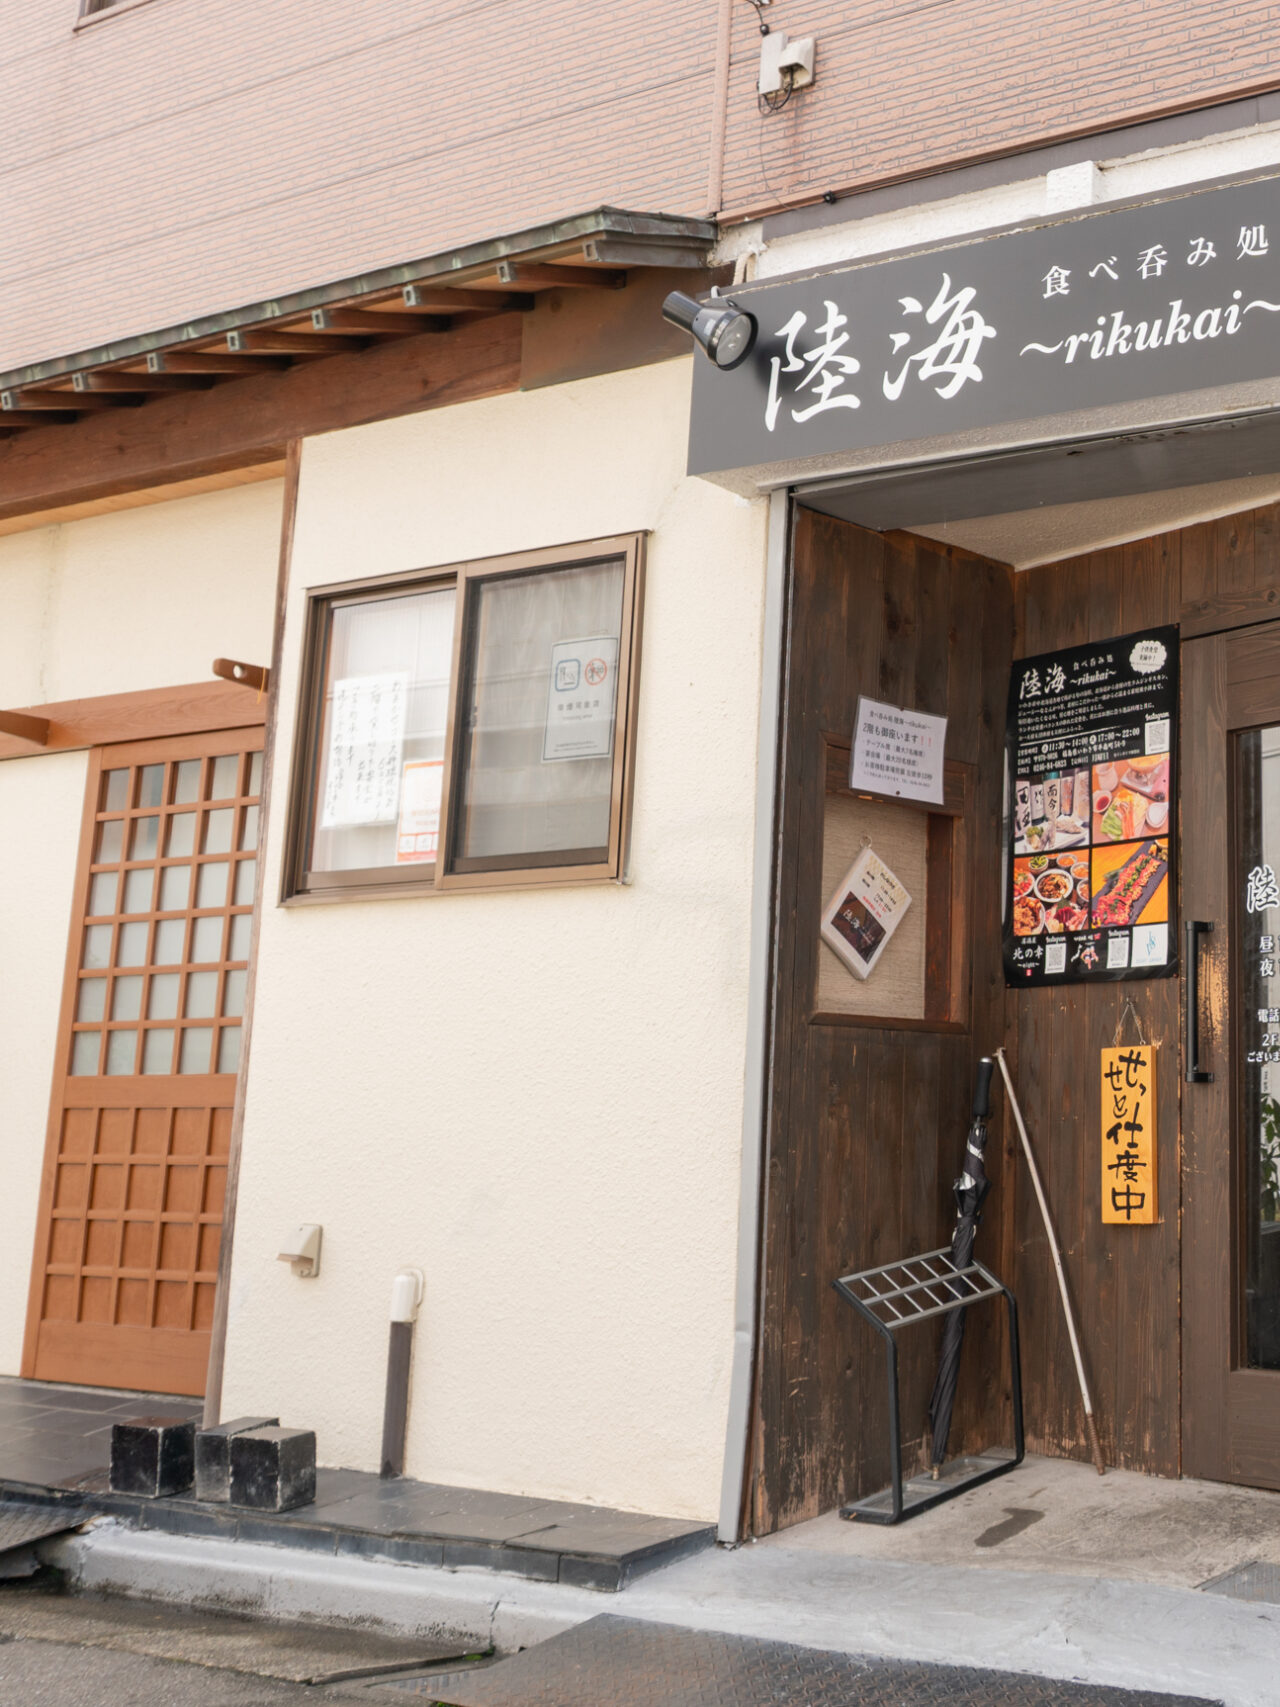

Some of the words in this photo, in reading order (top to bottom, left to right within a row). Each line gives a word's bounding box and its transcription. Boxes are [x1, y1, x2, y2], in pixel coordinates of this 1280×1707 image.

[1041, 224, 1271, 299] 食べ呑み処
[764, 272, 998, 432] 陸海
[1019, 663, 1067, 699] 陸海
